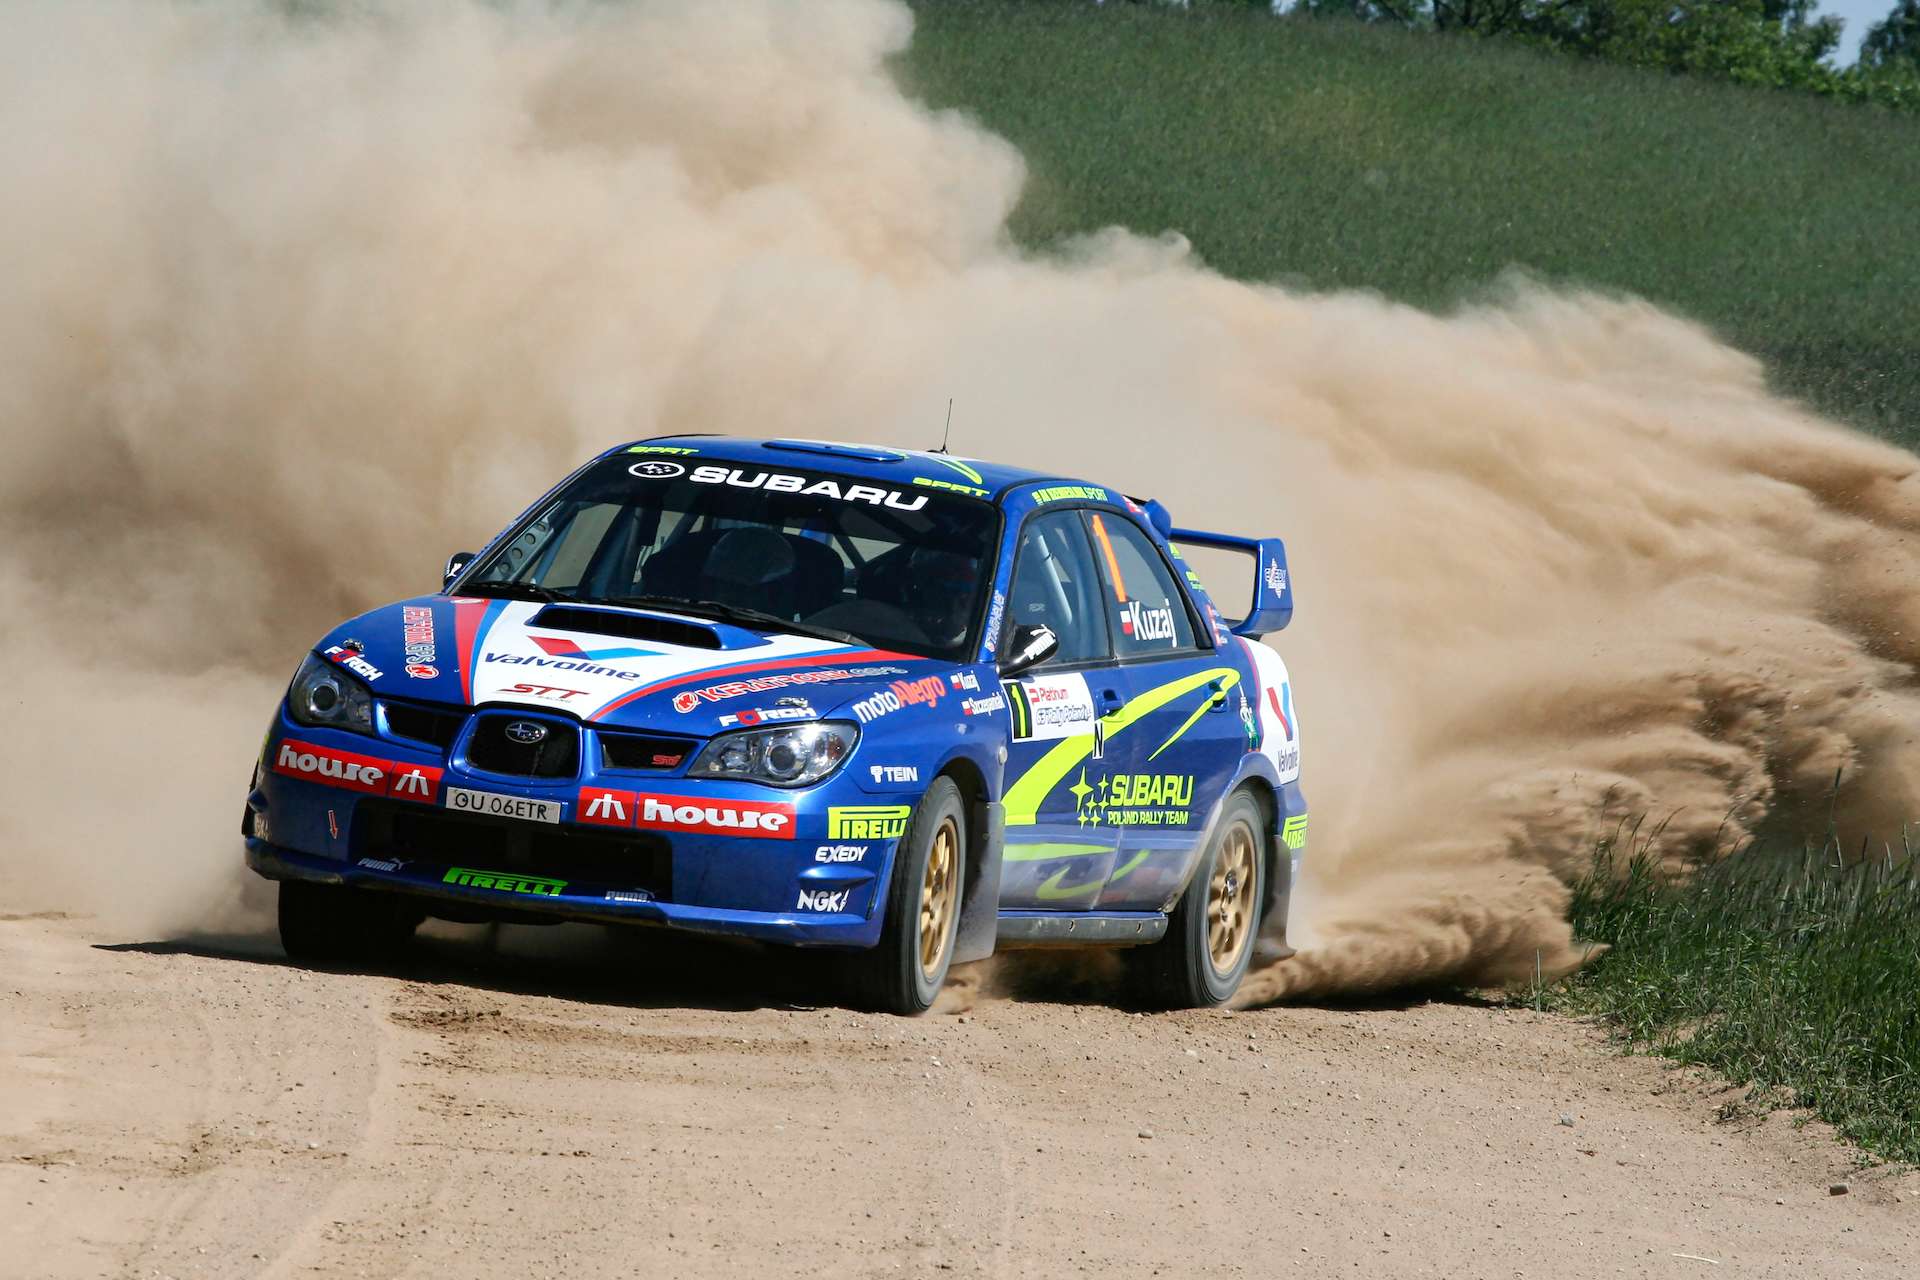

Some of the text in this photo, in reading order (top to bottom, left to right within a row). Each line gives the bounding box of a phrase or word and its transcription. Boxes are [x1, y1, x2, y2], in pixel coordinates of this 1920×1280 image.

[628, 446, 700, 455] SPRT
[689, 466, 928, 511] SUBARU
[912, 477, 990, 497] SPRT
[1092, 513, 1127, 602] 1
[1129, 598, 1177, 648] Kuzaj
[484, 653, 640, 681] Valvoline
[496, 683, 591, 699] STT
[1011, 684, 1027, 738] 1
[1093, 722, 1103, 758] N
[279, 744, 385, 786] house
[883, 766, 918, 782] TEIN
[1110, 774, 1194, 807] SUBARU
[491, 797, 548, 820] 06ETR
[643, 798, 789, 831] house
[827, 805, 912, 840] PIRELLI
[1108, 811, 1189, 825] POLAND RALLY TEAM
[815, 845, 868, 863] EXEDY
[442, 867, 568, 897] PIRELLI
[797, 889, 843, 913] NGK
